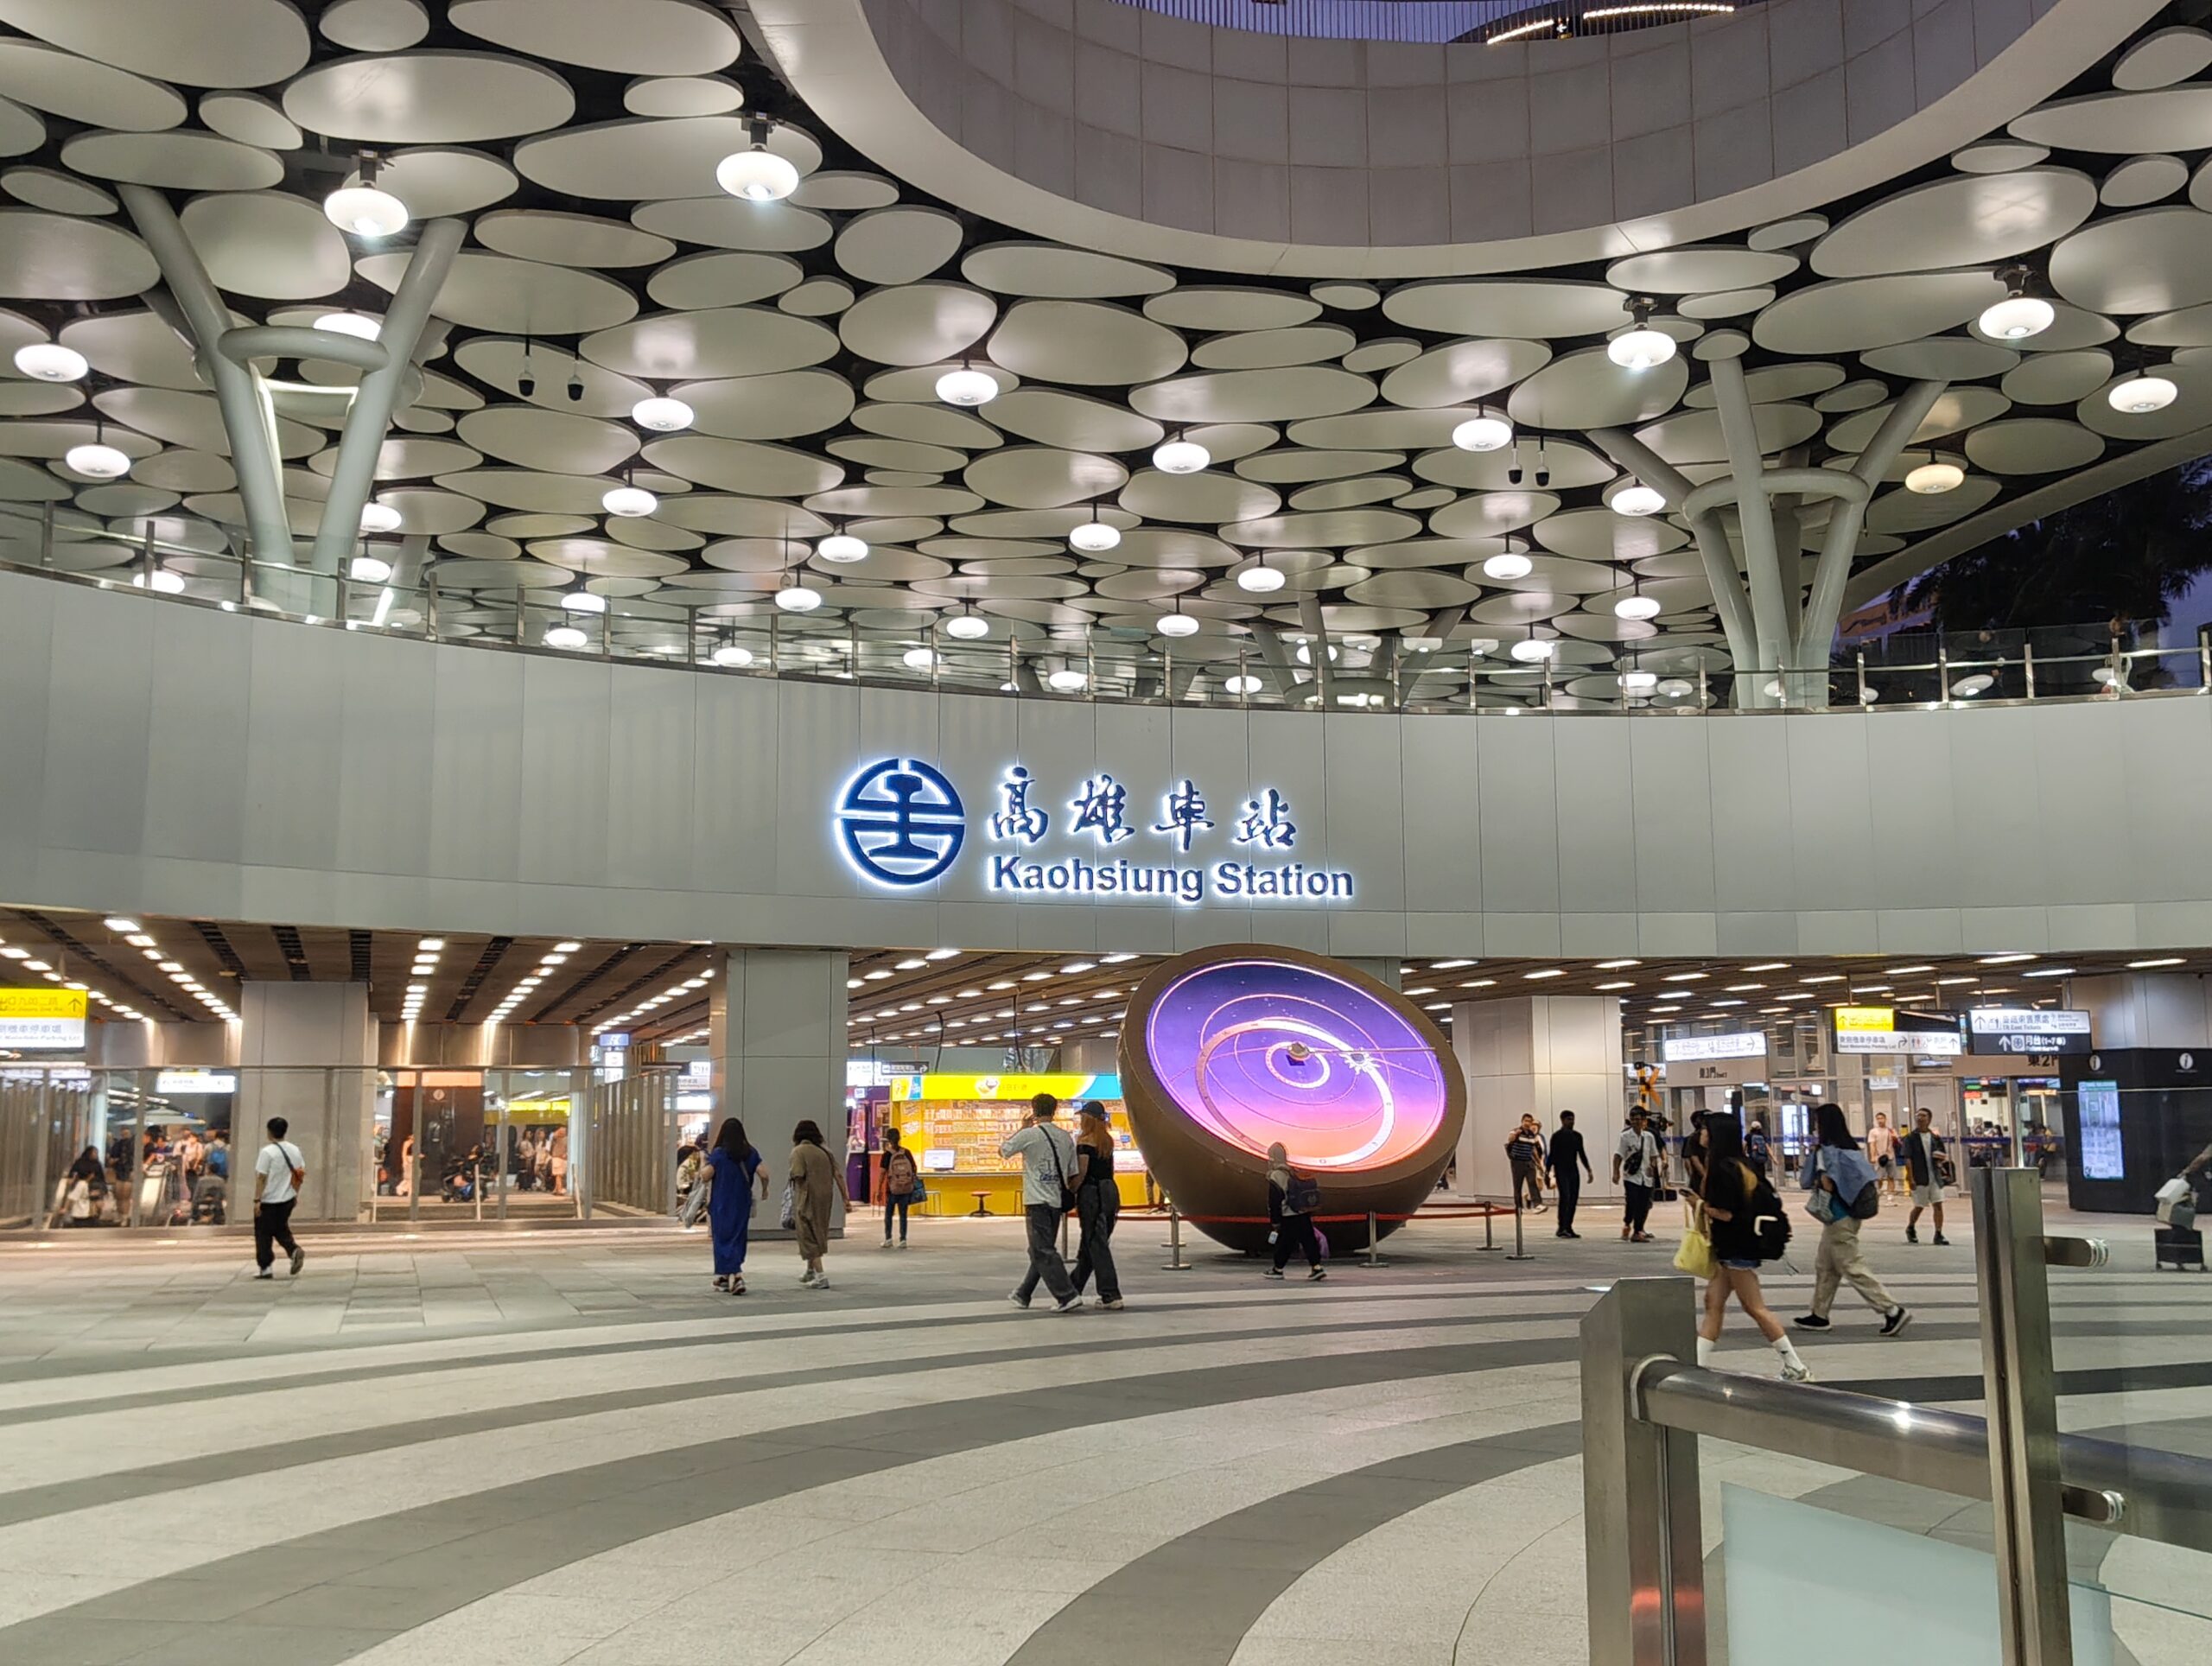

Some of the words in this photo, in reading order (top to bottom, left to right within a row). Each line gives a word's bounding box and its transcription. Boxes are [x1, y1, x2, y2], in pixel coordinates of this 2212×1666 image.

[992, 766, 1297, 851] 高雄車站
[993, 855, 1204, 902] Kaohsiung
[1216, 862, 1354, 897] Station
